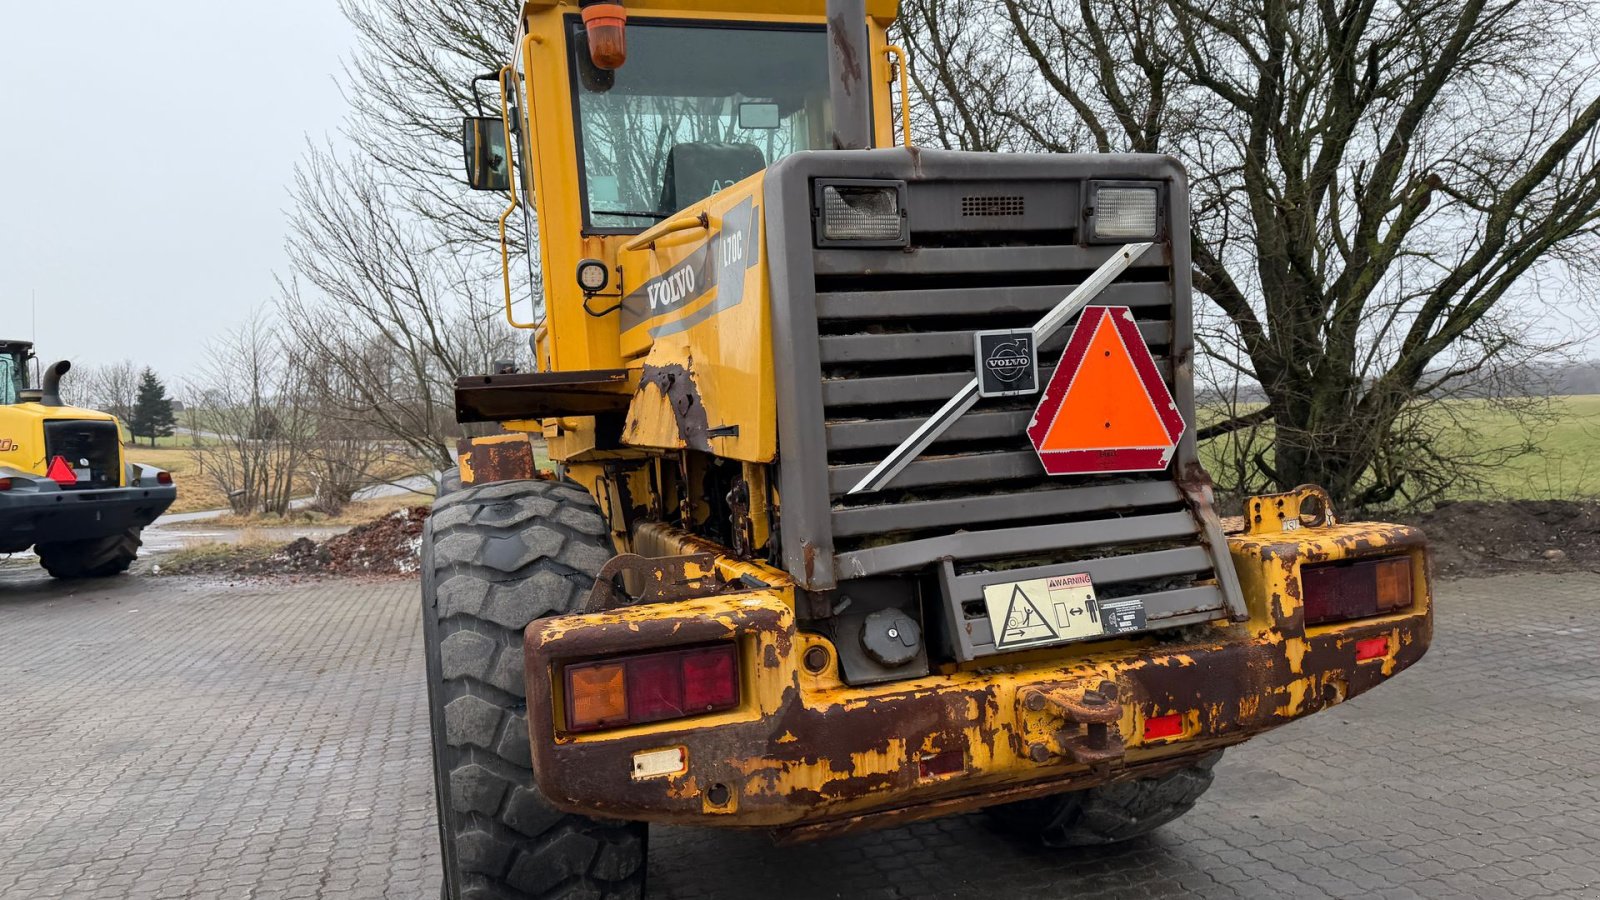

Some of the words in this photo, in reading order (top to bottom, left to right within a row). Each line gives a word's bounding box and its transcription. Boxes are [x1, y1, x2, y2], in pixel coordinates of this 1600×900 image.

[647, 264, 695, 310] VOLVO
[989, 358, 1027, 366] VOLVO
[1054, 576, 1090, 586] WARNING
